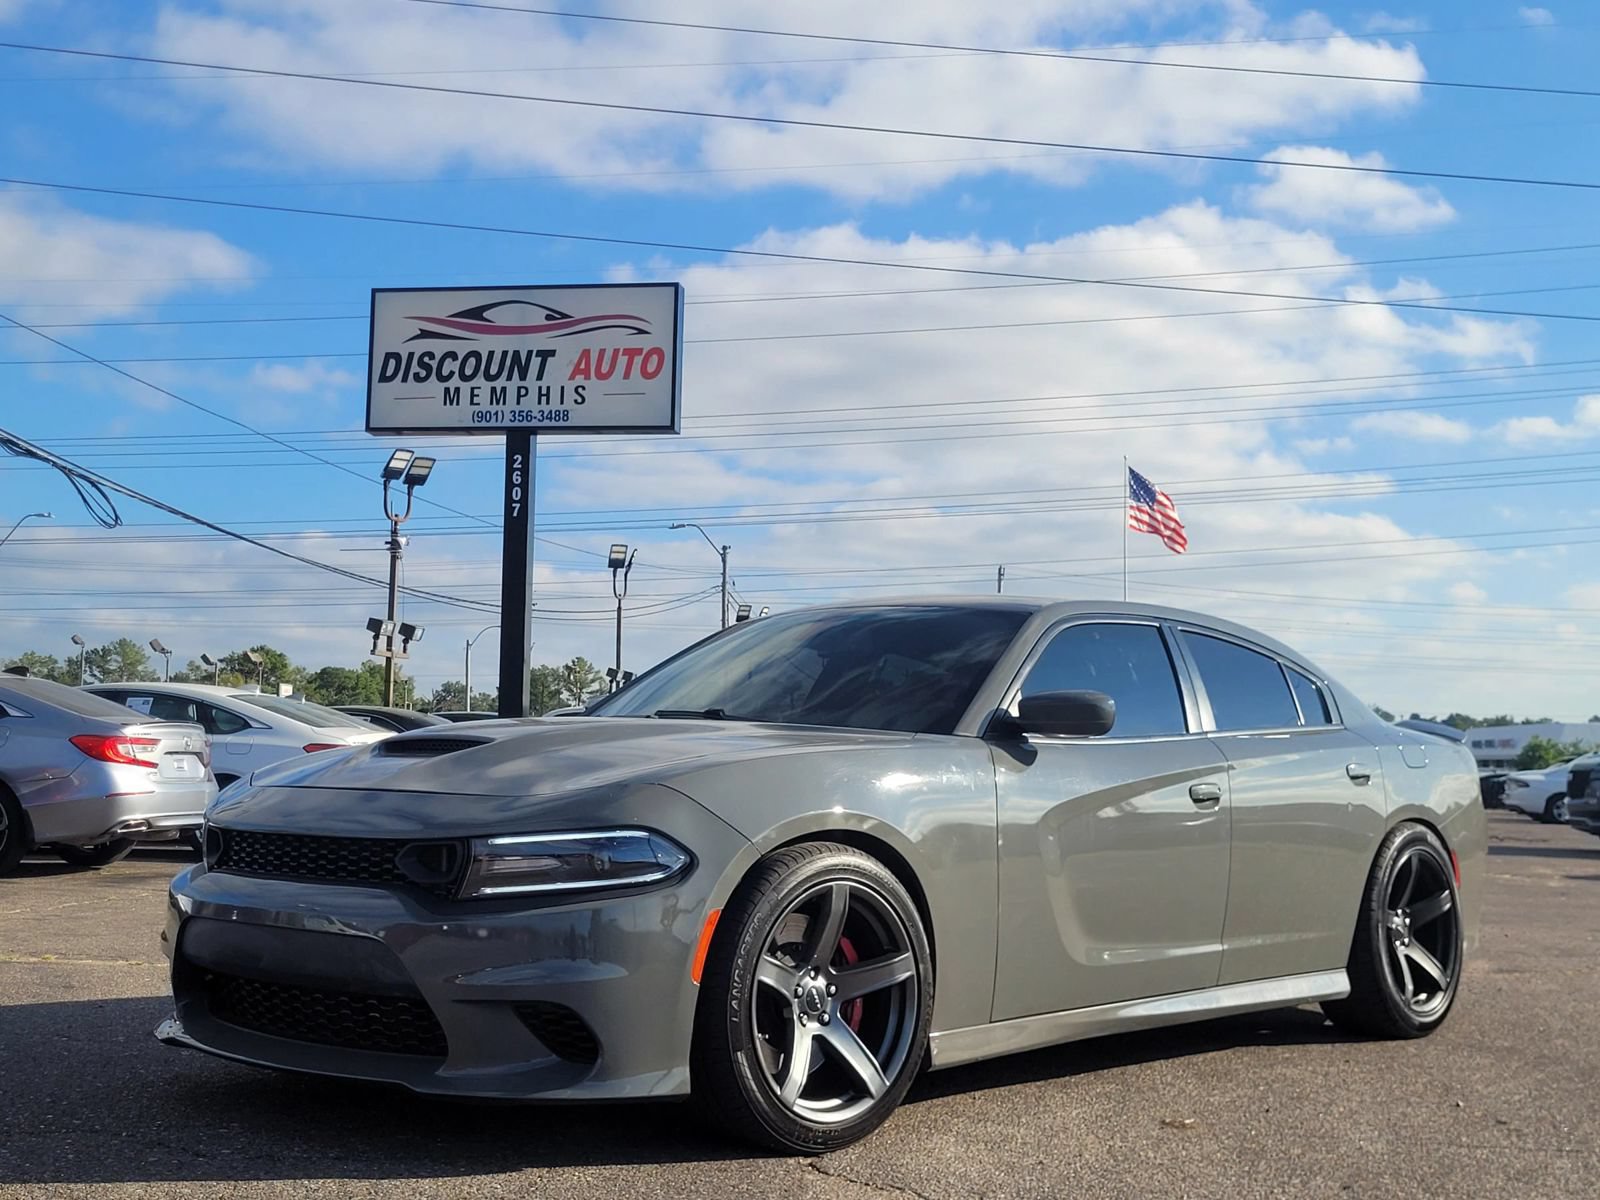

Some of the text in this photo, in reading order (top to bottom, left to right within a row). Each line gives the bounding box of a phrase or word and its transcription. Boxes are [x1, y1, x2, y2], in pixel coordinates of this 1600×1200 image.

[377, 346, 666, 384] DISCOUNT AUTO
[442, 384, 587, 407] MEMPHIS
[471, 409, 570, 424] (901) 356-3488
[511, 454, 523, 517] 2607
